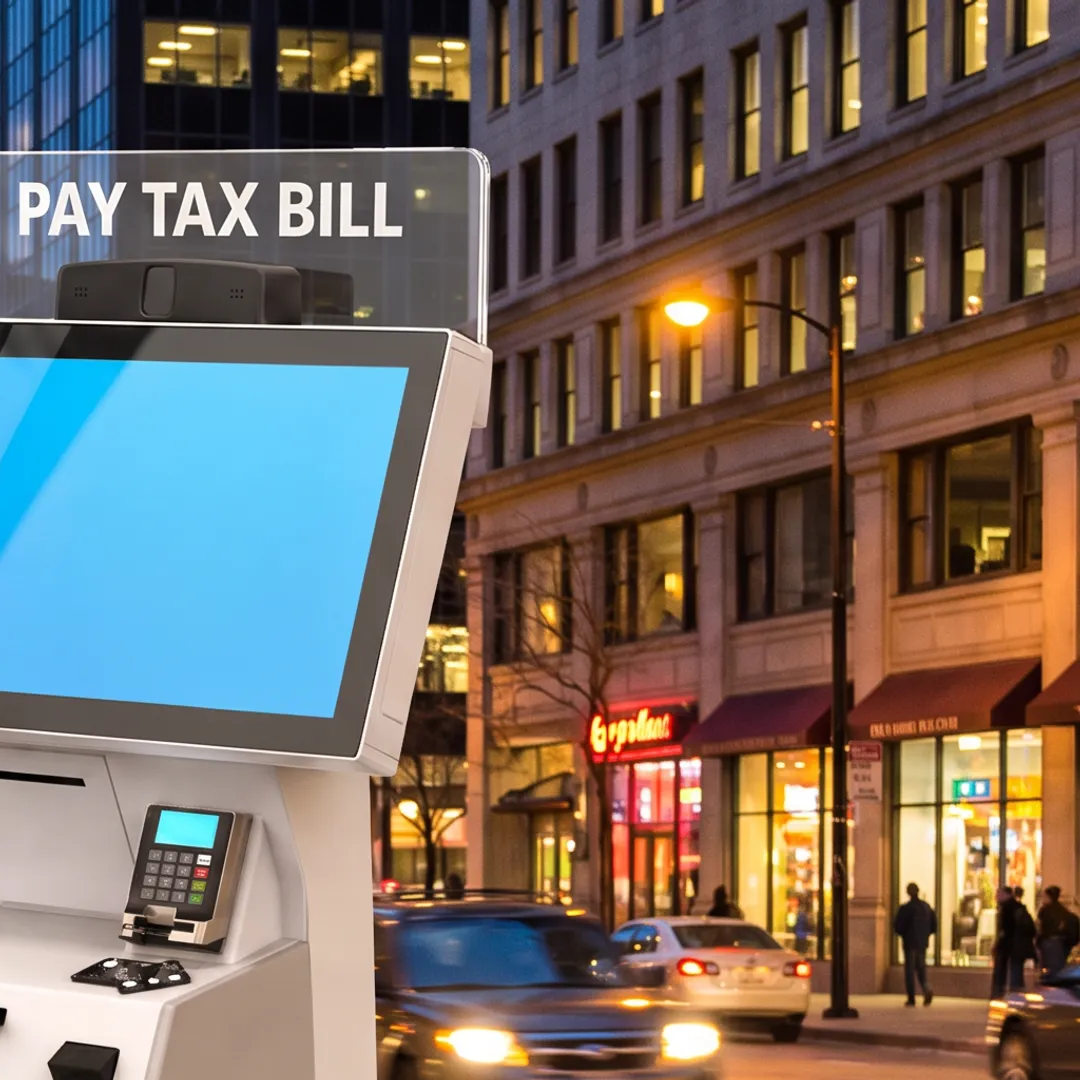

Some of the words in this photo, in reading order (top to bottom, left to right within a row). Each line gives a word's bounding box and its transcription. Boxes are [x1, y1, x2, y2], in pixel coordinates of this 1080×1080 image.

[18, 181, 128, 237] PAY
[141, 181, 260, 237] TAX
[278, 181, 404, 238] BILL
